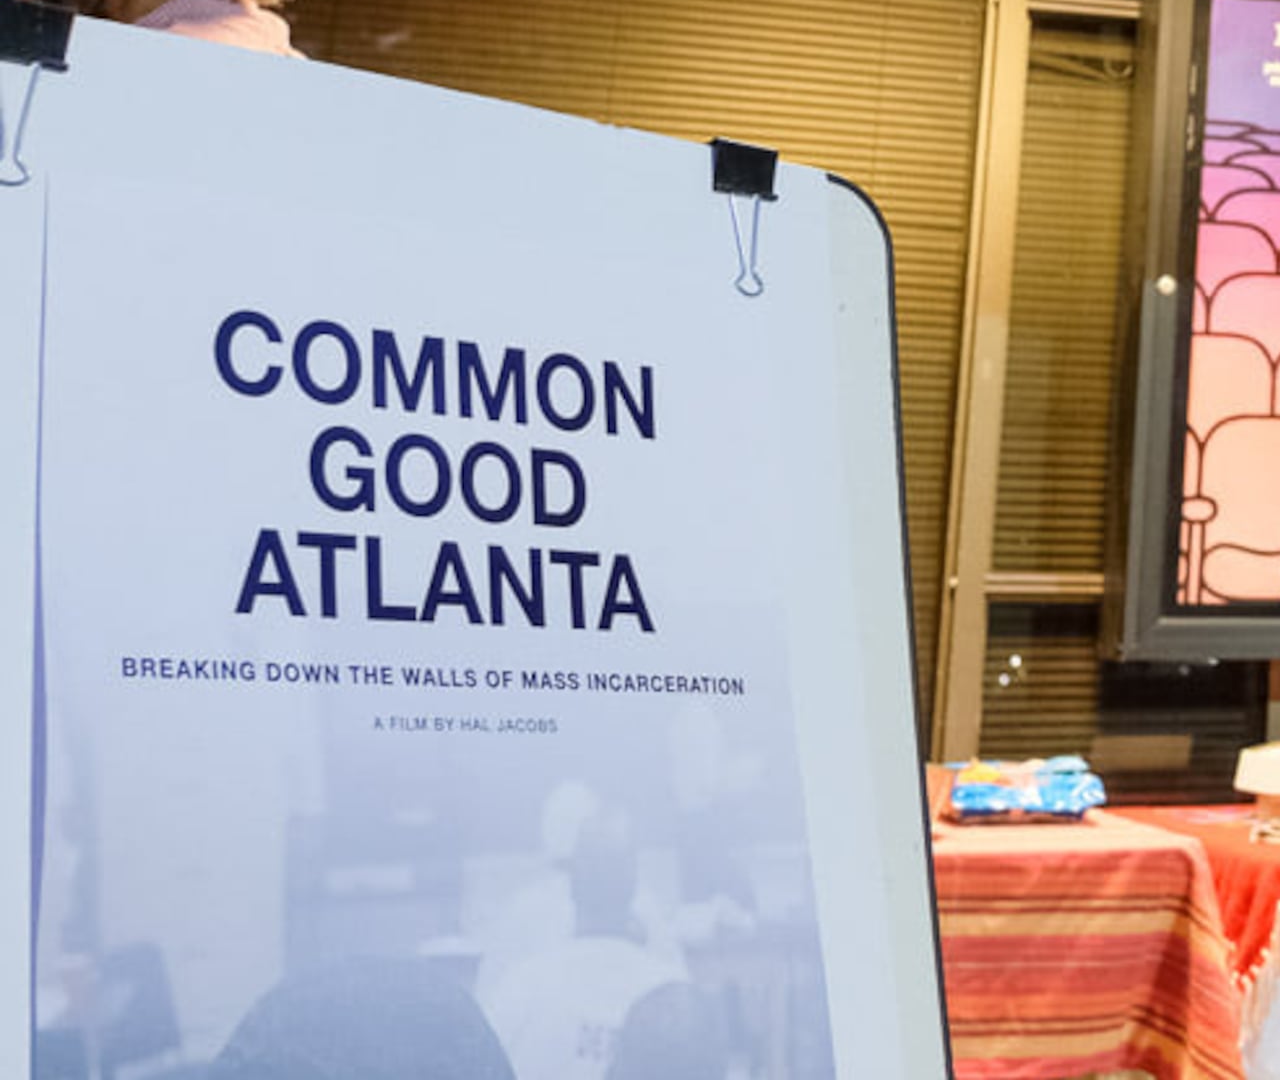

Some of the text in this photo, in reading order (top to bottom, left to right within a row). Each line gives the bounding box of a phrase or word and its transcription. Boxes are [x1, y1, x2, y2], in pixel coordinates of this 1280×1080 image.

[214, 310, 657, 440] COMMON
[309, 426, 587, 528] GOOD
[235, 528, 656, 634] ATLANTA
[121, 657, 744, 696] BREAKING DOWN THE WALLS OF MASS INCARCERATION
[374, 716, 559, 734] A FILM BY HAL JACOBS
